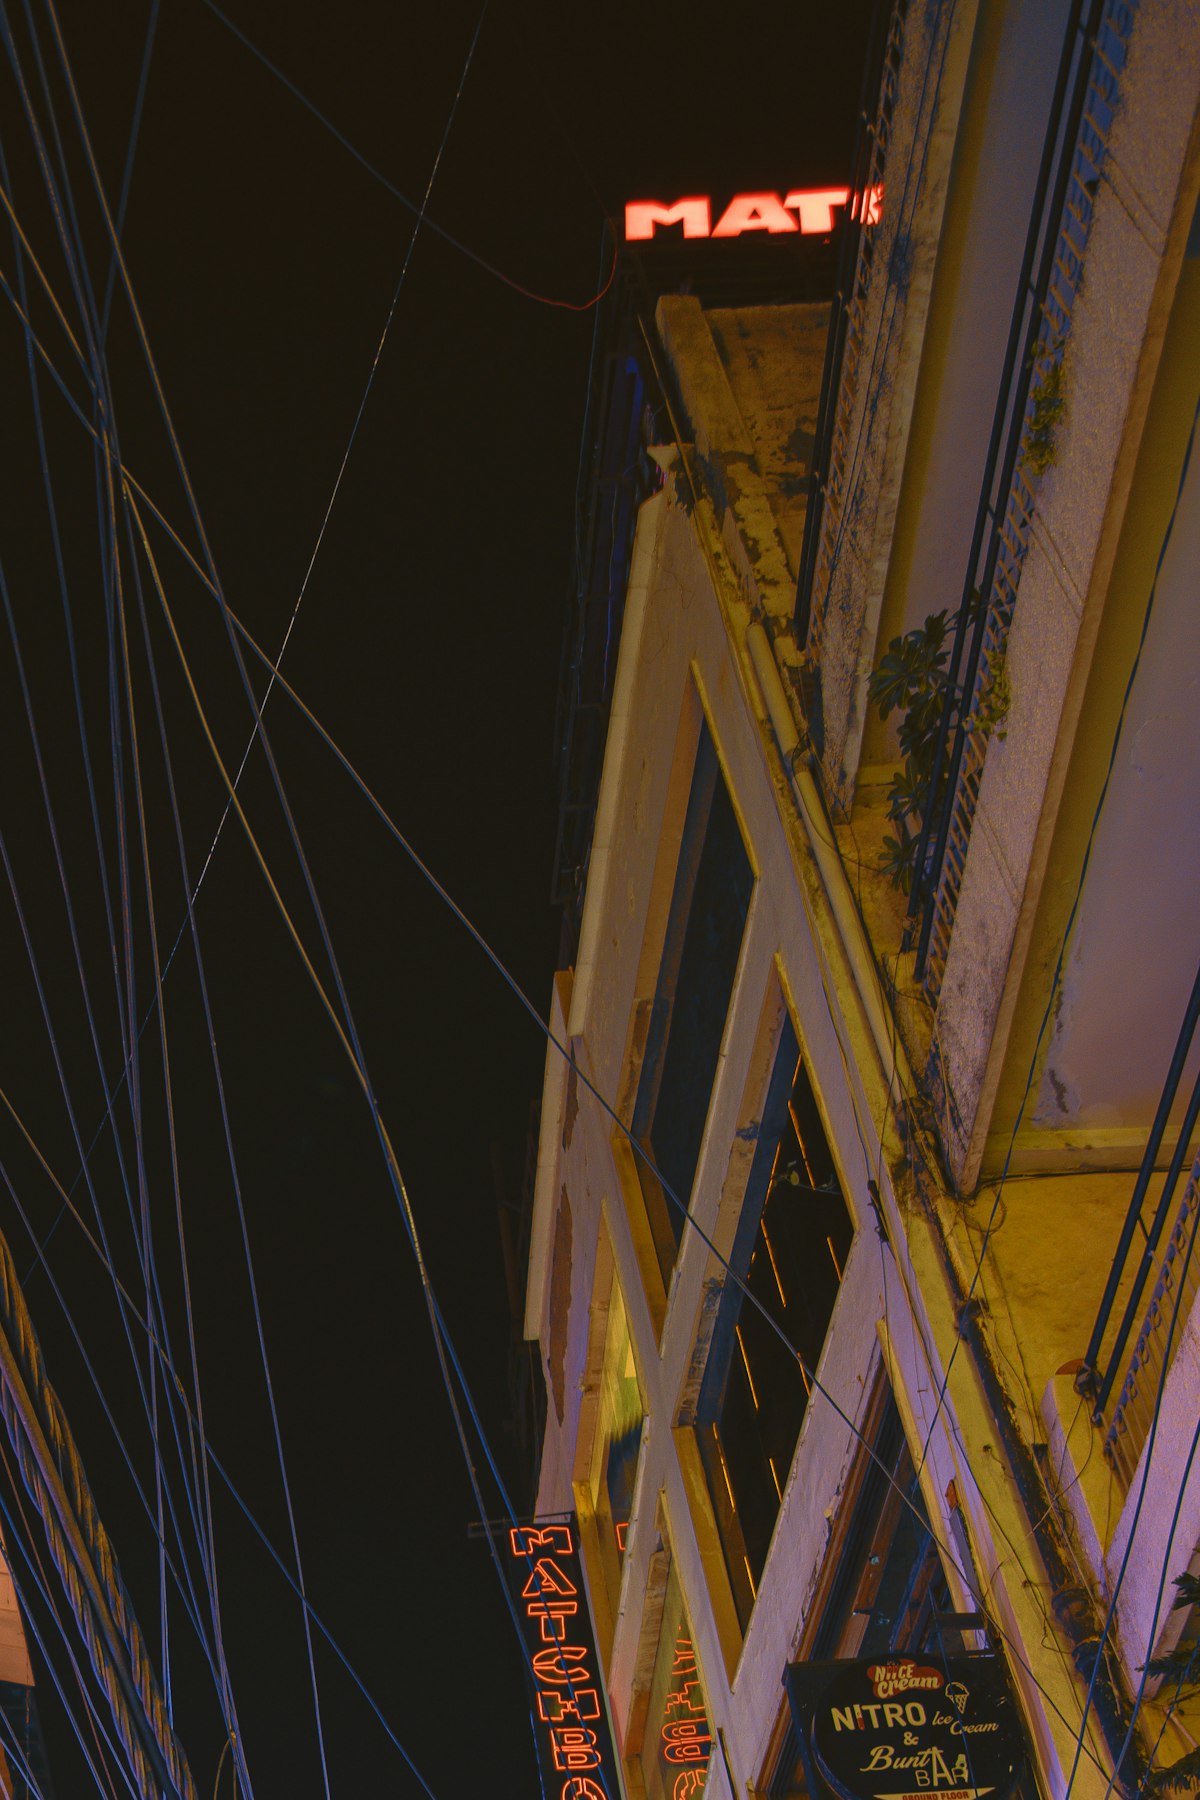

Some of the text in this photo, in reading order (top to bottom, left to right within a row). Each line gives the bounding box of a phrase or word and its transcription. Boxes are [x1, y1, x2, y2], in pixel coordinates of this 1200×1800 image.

[830, 1701, 953, 1732] NITRO Ice
[950, 1720, 1000, 1736] Cream
[941, 1790, 970, 1800] FLOOR
